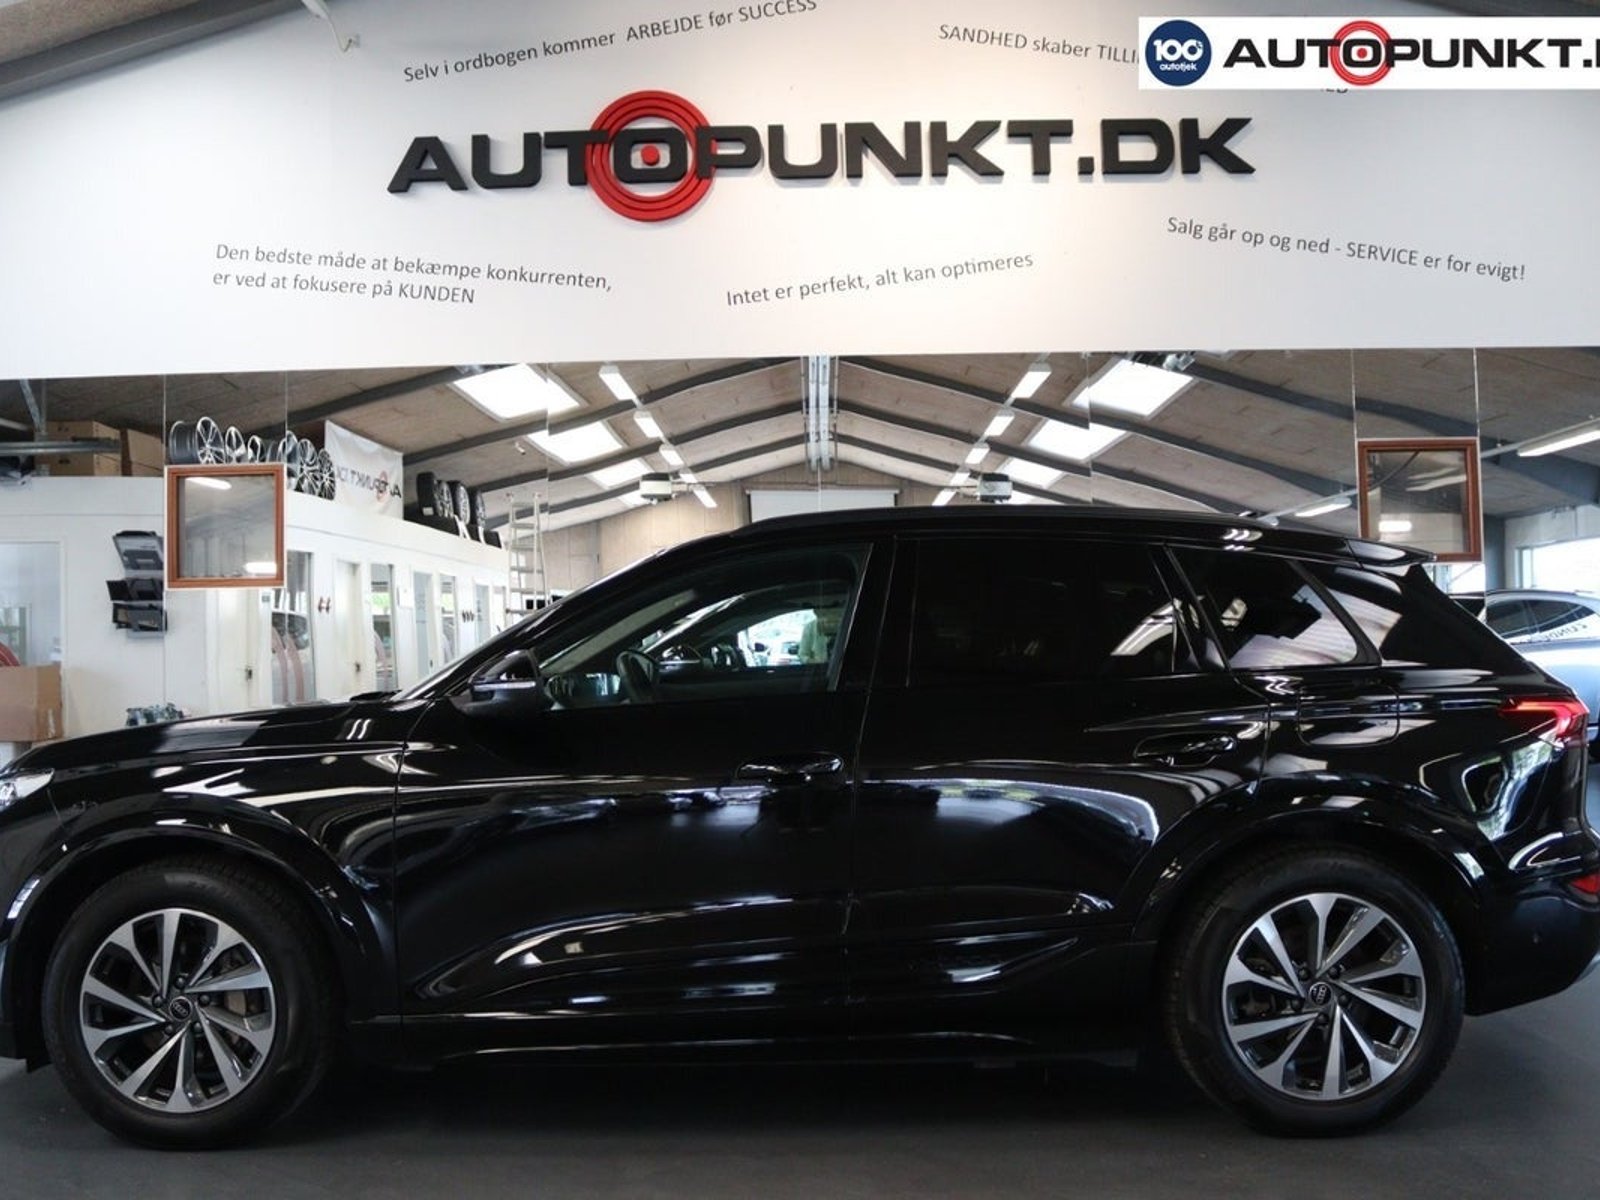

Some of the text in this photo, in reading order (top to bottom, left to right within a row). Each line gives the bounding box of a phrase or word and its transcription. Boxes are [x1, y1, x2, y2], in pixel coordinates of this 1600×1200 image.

[403, 0, 817, 82] Selv i ordbogen kommer ARBEJDE før SUCCESS
[938, 24, 1138, 65] SANDHED skaber TILLI
[387, 117, 1255, 193] AUTOPUNKT.DK
[216, 244, 612, 292] Den bedste måde at bekæmpe konkurrenten,
[1167, 216, 1204, 240] Salg
[1208, 223, 1237, 242] går
[1241, 230, 1264, 248] op
[1269, 234, 1291, 252] og
[1296, 238, 1330, 254] ned
[1346, 241, 1418, 266] SERVICE
[1423, 255, 1442, 269] er
[1447, 254, 1472, 273] for
[1476, 262, 1525, 282] evigt!
[213, 272, 475, 304] er ved at fokusere på KUNDEN
[727, 255, 1033, 306] Intet er perfekt, alt kan optimeres
